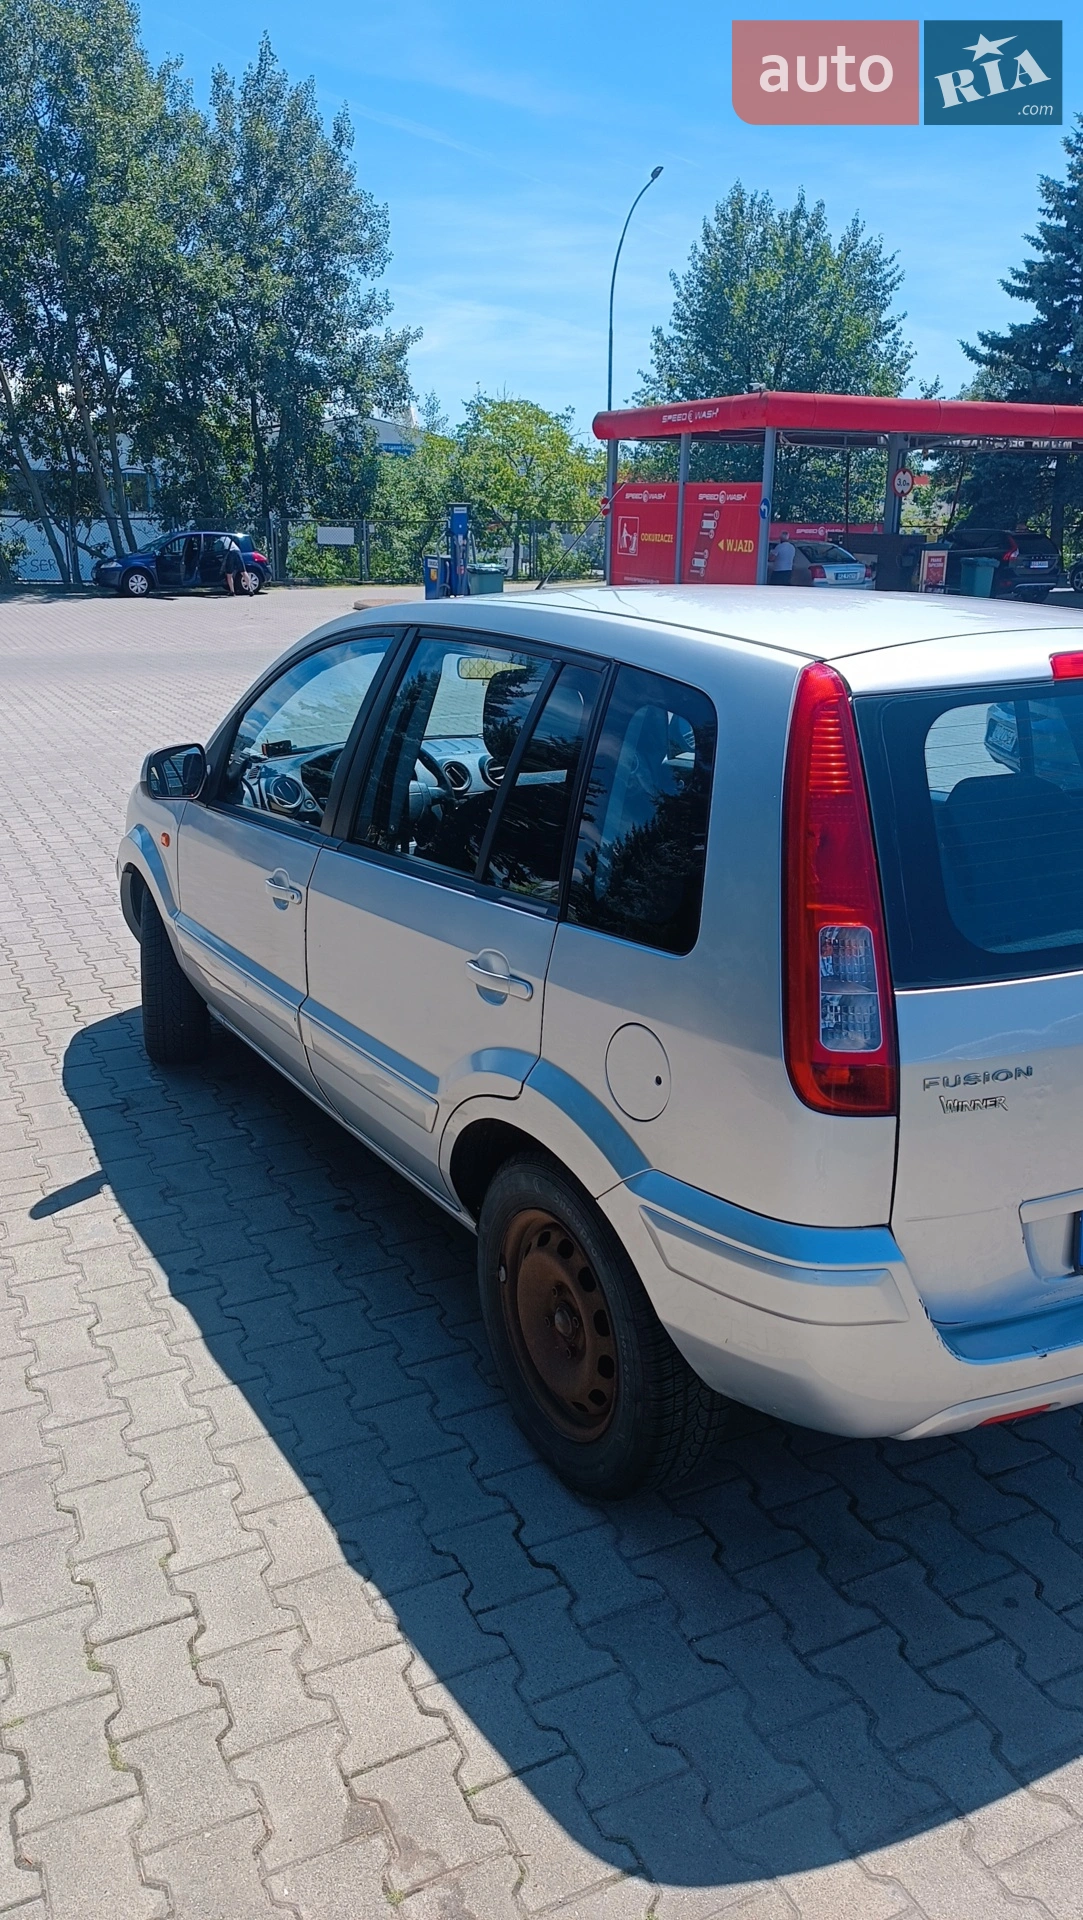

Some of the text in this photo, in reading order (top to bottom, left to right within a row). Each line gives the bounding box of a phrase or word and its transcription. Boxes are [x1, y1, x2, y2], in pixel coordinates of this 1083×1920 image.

[662, 408, 719, 423] SPEED WASH
[649, 491, 666, 500] WASH
[727, 491, 747, 501] WASH
[640, 533, 673, 543] ODKURZACZE
[726, 539, 754, 553] WJAZD
[923, 1065, 1033, 1091] FUSION
[939, 1095, 1008, 1114] WINNER
